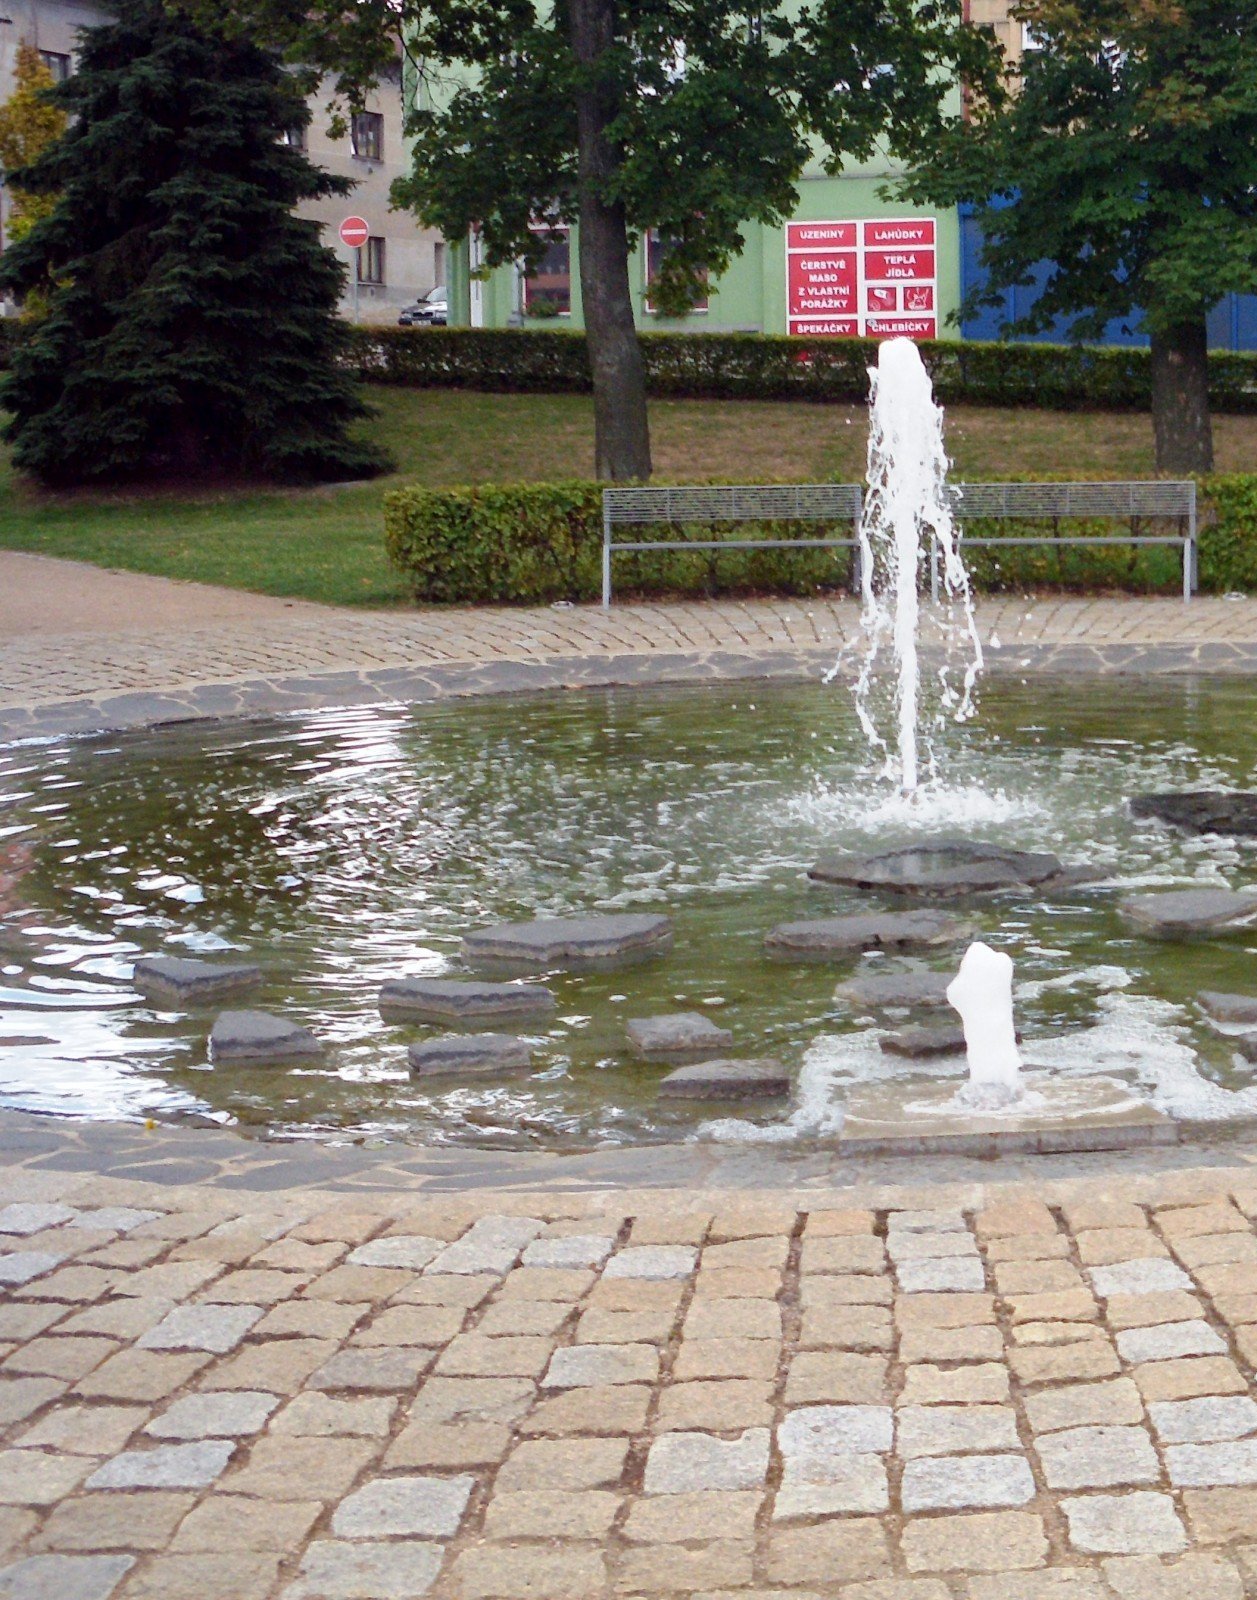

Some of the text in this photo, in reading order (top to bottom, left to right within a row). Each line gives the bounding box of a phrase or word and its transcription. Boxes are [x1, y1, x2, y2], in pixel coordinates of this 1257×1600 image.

[800, 229, 844, 239] UZENINY
[800, 259, 846, 270] ČERSTVÉ
[884, 254, 916, 265] TEPLÁ
[885, 268, 914, 277] JÍDLA
[809, 274, 837, 283] MASO
[798, 285, 850, 296] Z VLASTNÍ
[801, 298, 848, 308] PORÁŽKY
[797, 323, 850, 333] ŠPEKÁČKY
